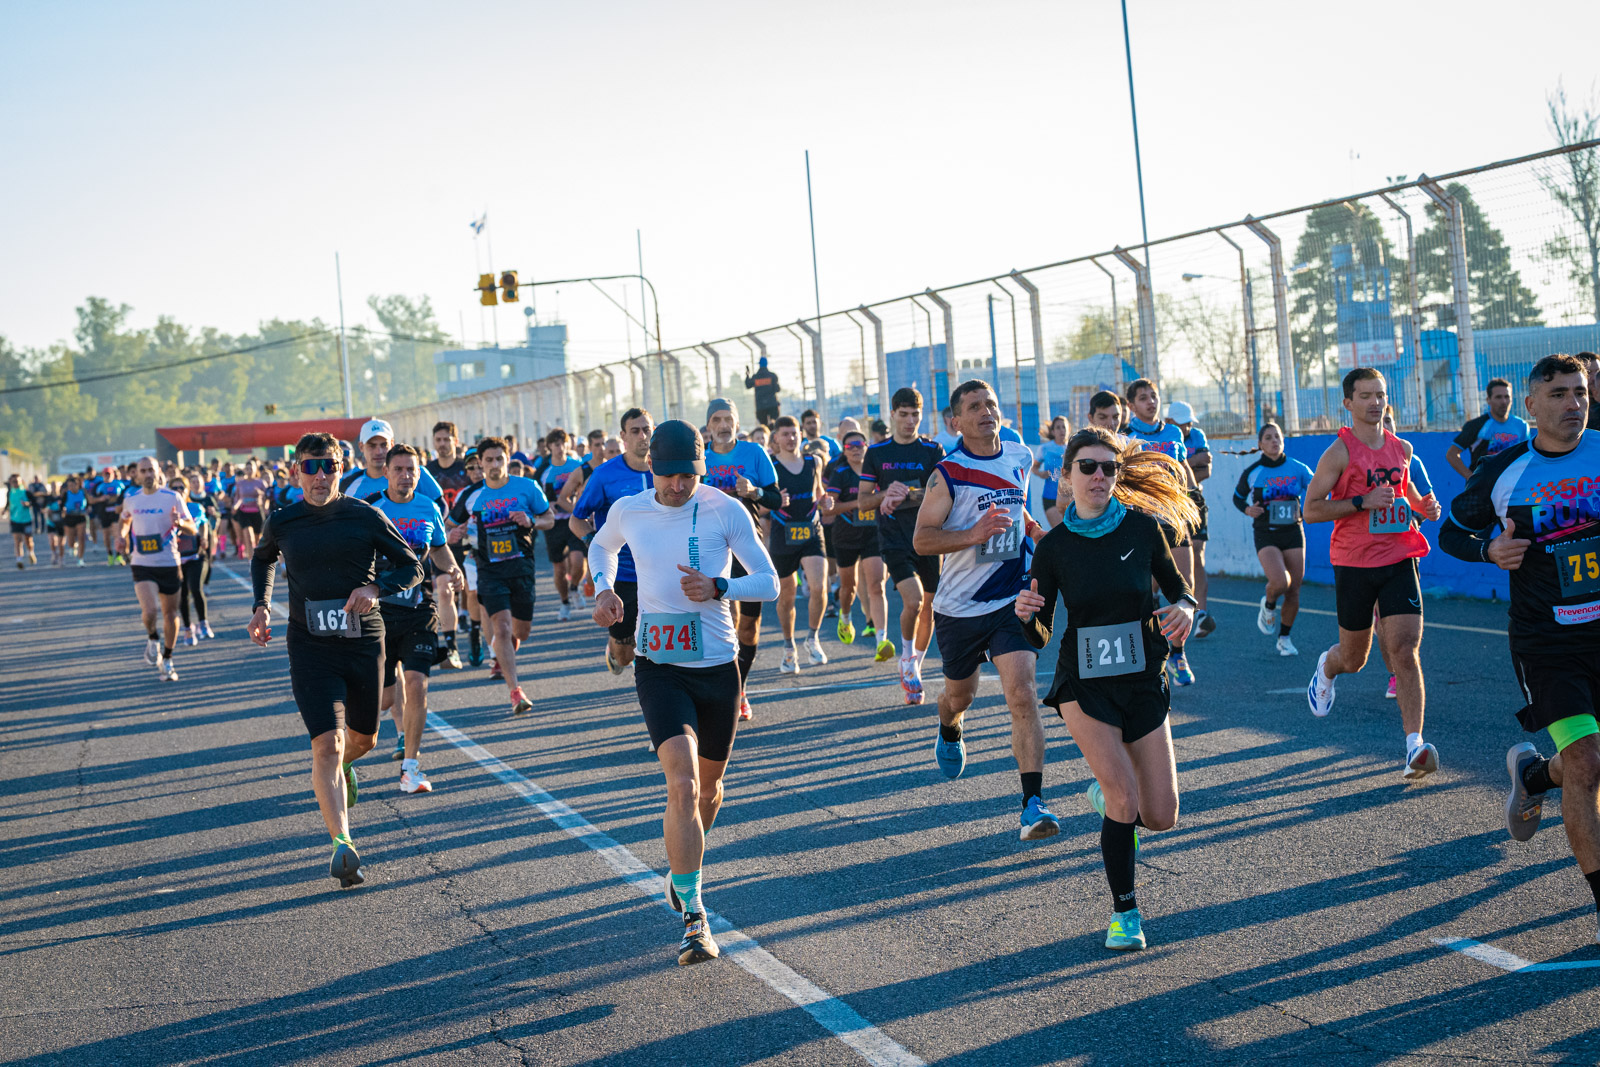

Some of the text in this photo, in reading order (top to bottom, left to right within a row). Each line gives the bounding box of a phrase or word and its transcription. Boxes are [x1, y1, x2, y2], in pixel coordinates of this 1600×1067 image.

[882, 462, 924, 471] RUNNEA
[1367, 467, 1401, 487] KRC
[978, 489, 1024, 503] ATLETISMO
[978, 497, 1024, 511] BRNKMANN
[1279, 505, 1291, 519] 31
[1379, 506, 1405, 524] 316
[790, 527, 811, 540] 729
[986, 531, 1014, 554] 144
[141, 540, 158, 552] 722
[492, 541, 512, 553] 725
[317, 609, 348, 631] 167
[648, 625, 691, 652] 374
[1085, 637, 1093, 669] TIEMPO
[1097, 637, 1126, 666] 21
[1129, 633, 1137, 664] EXACTO
